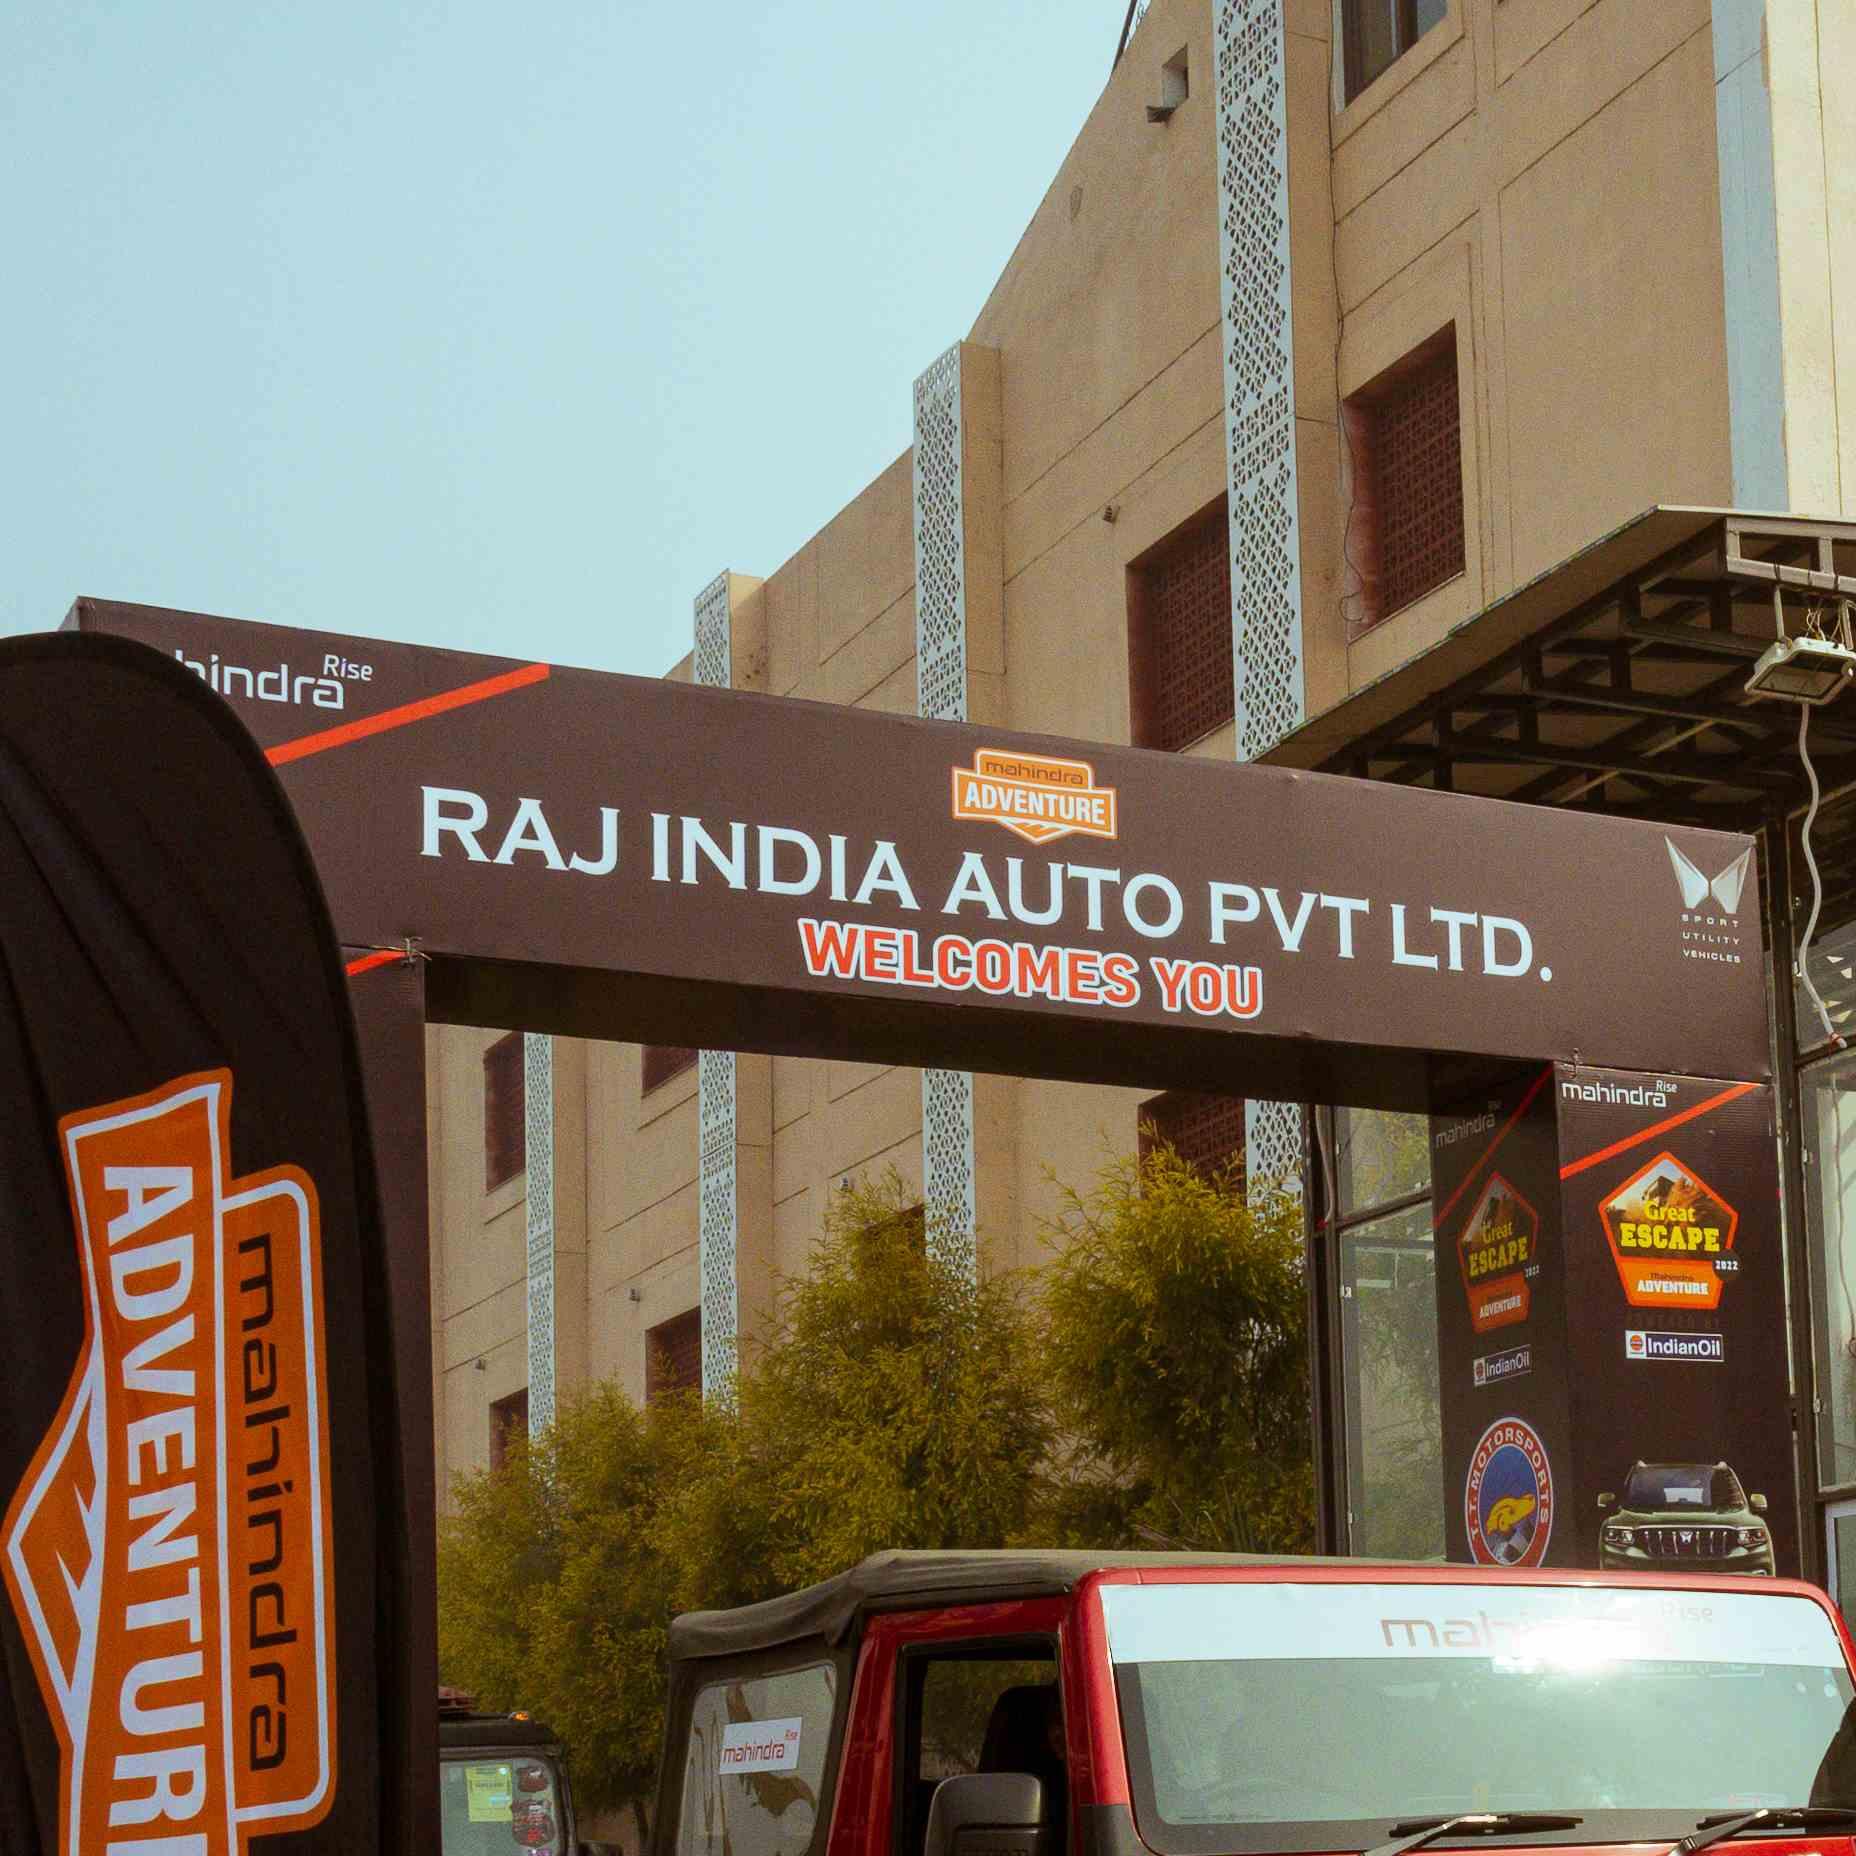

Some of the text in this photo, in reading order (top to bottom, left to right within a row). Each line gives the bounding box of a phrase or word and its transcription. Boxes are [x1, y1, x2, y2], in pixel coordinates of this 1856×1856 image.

[323, 654, 374, 682] Rise
[985, 760, 1084, 785] mahindra
[964, 781, 1105, 826] ADVENTURE
[420, 786, 1552, 982] RAJ INDIA AUTO PVT LTD.
[1681, 914, 1739, 928] SPORT
[1682, 931, 1740, 945] UTILITY
[801, 919, 1263, 1020] WELCOMES YOU
[1683, 949, 1741, 963] VEHICLES
[1562, 1080, 1678, 1108] mahindra Rise
[1436, 1112, 1496, 1148] mahindra
[1644, 1198, 1696, 1222] Great
[1481, 1219, 1514, 1245] Great
[1620, 1223, 1721, 1252] ESCAPE
[1469, 1236, 1529, 1277] ESCAPE
[1715, 1260, 1739, 1271] 2022
[1638, 1279, 1709, 1295] ADVENTURE
[1479, 1295, 1522, 1319] ADVENTURE
[1647, 1337, 1721, 1357] IndianOil
[1486, 1351, 1530, 1378] IndianOil
[238, 1232, 298, 1773] mahindra
[723, 1736, 786, 1763] mahindra
